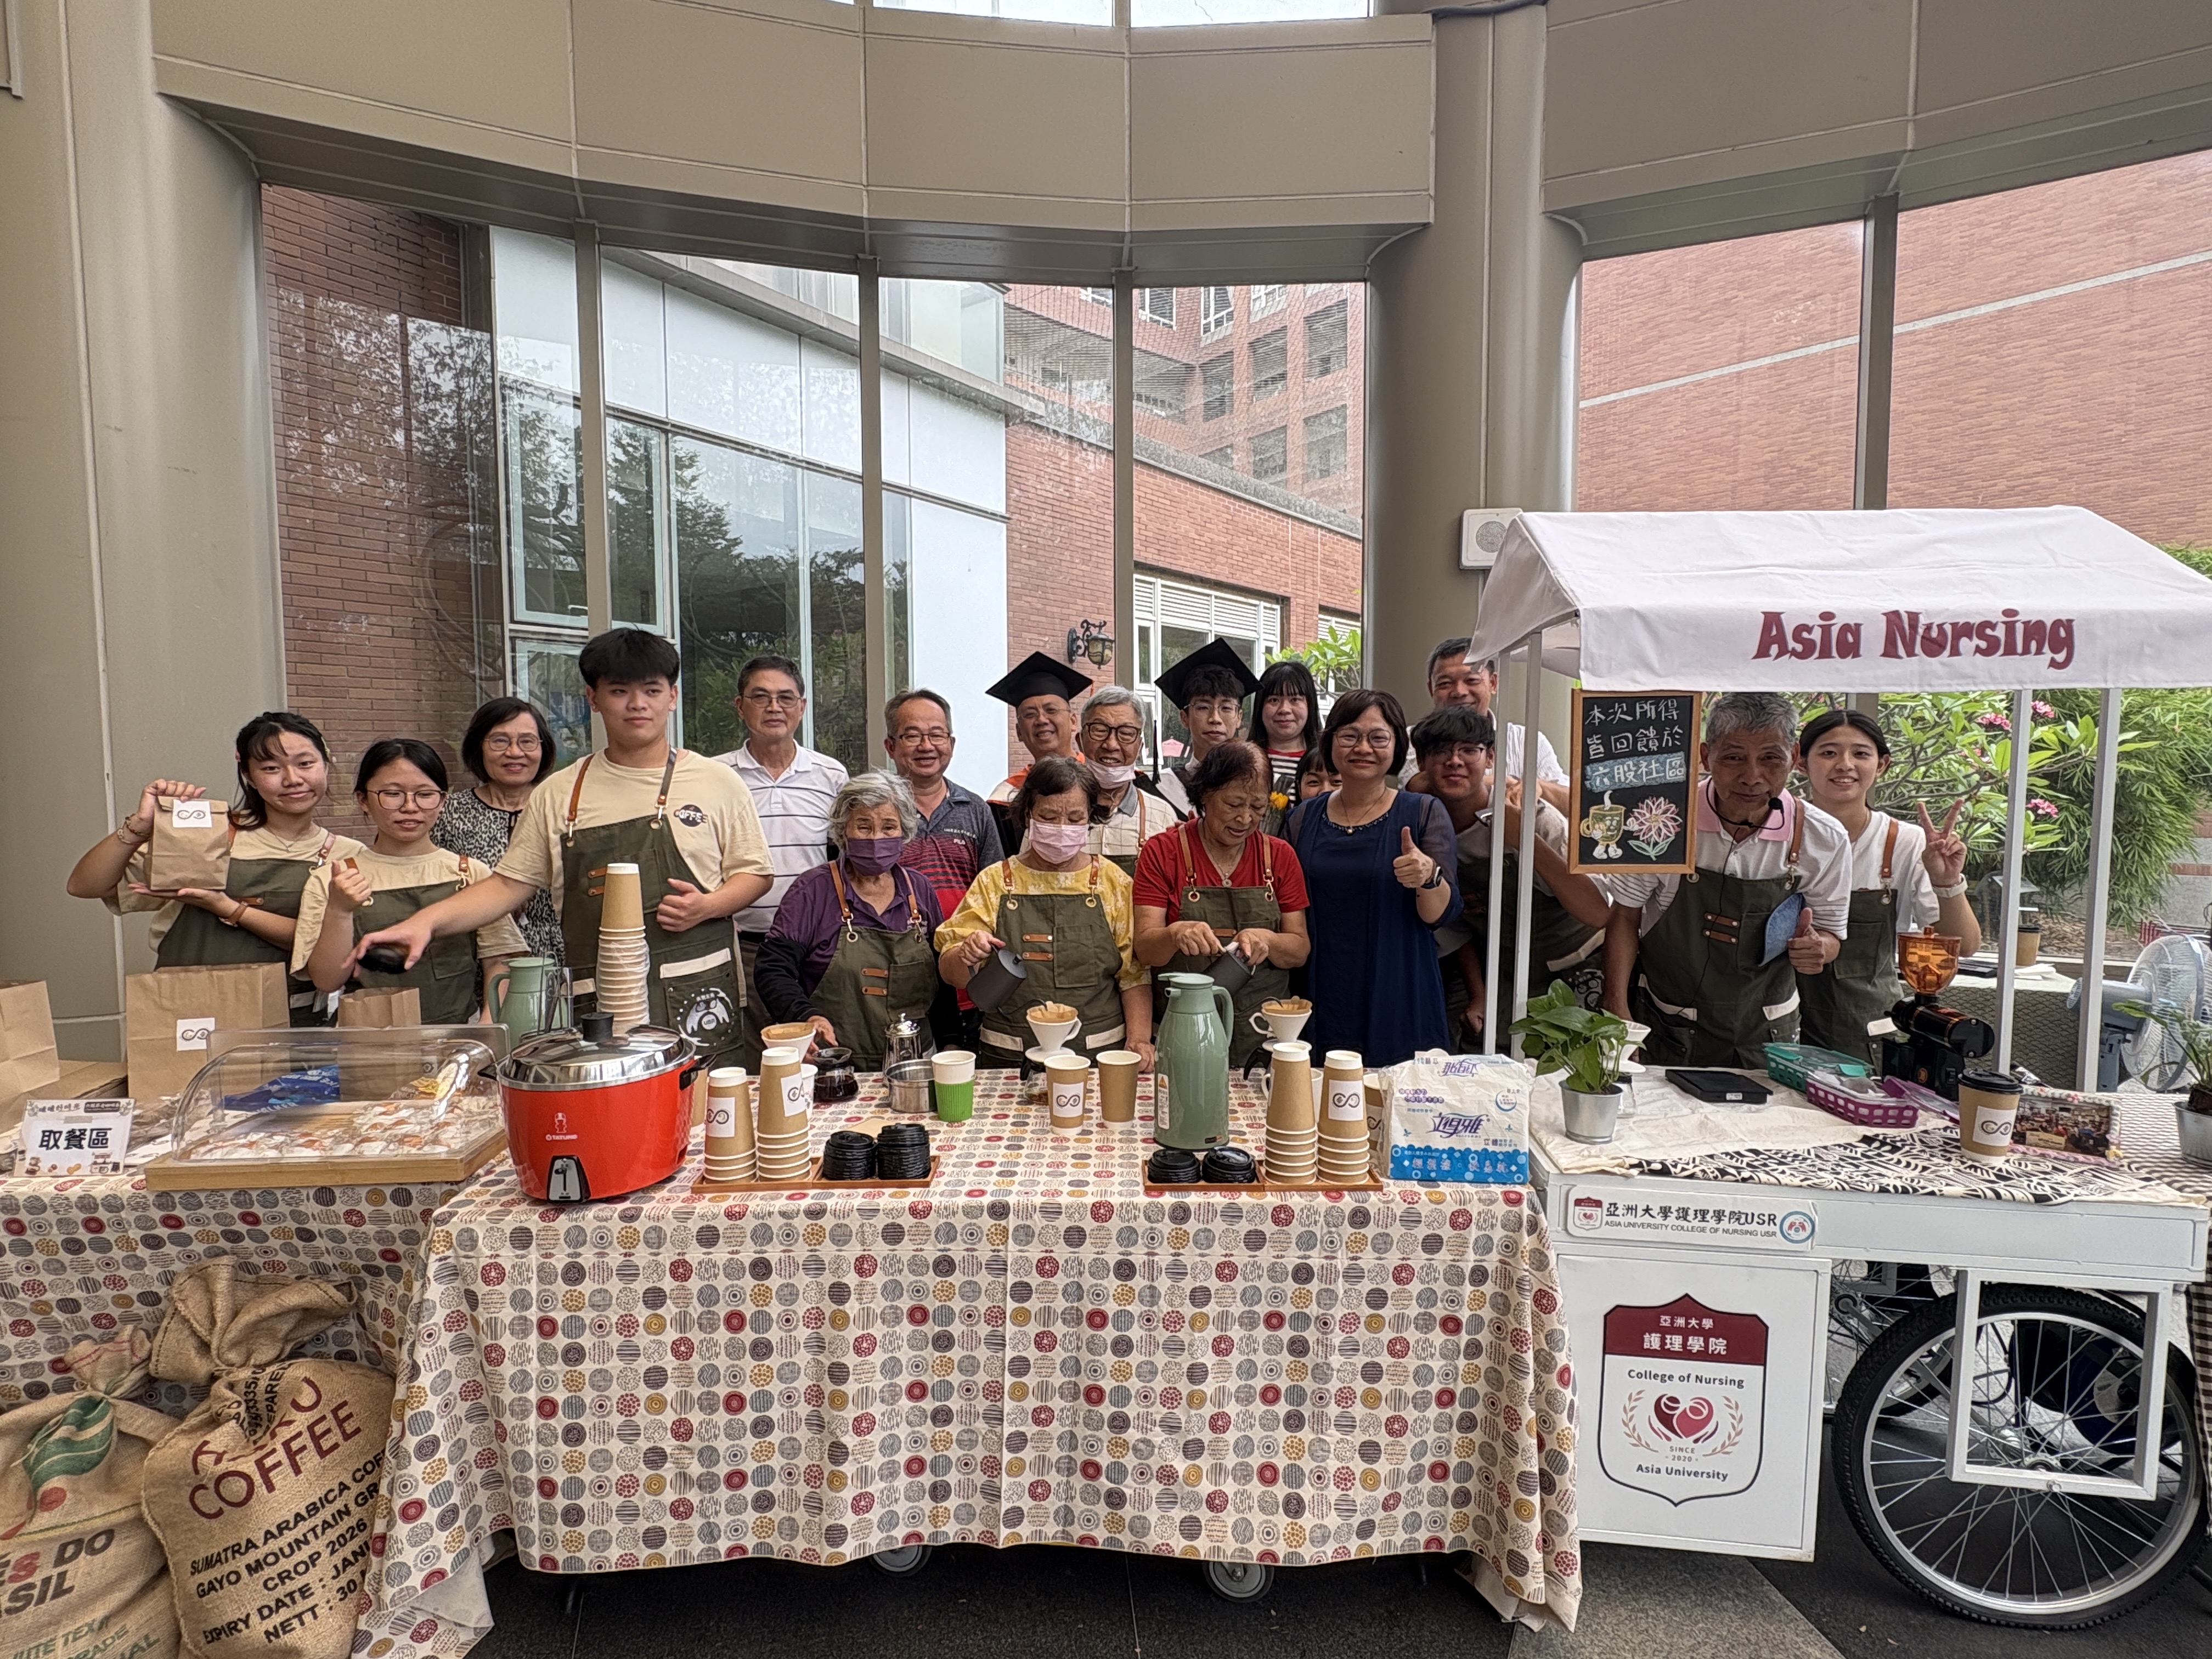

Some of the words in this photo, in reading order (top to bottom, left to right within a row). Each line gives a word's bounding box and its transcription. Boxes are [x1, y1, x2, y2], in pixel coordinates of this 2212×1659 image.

[1751, 611, 1864, 661] Asia
[1878, 608, 2076, 670] Nursing
[1584, 698, 1680, 727] 本次所得
[1586, 725, 1684, 760] 皆回饋於
[1592, 756, 1685, 787] 六股社區
[38, 1127, 113, 1151] 取餐區
[1604, 1220, 1623, 1228] ASIA
[1623, 1221, 1670, 1231] UNIVERSITY
[1671, 1224, 1707, 1234] COLLEGE
[1722, 1228, 1759, 1237] NURSING
[1605, 1201, 1778, 1227] 亞洲大學護理學院USR
[1659, 1315, 1714, 1330] 亞洲大學
[1643, 1332, 1728, 1356] 護理學院
[1627, 1369, 1674, 1384] College
[1678, 1373, 1692, 1383] of
[1695, 1374, 1745, 1390] Nursing
[189, 1400, 362, 1520] COFFEE
[1669, 1446, 1696, 1454] SINCE
[1671, 1454, 1692, 1463] 2020
[1635, 1464, 1662, 1475] Asia
[1665, 1466, 1729, 1482] University
[190, 1537, 260, 1576] SUMATRA
[262, 1481, 352, 1546] ARABICA
[53, 1528, 115, 1569] DO
[196, 1570, 241, 1599] GAYO
[245, 1503, 352, 1578] MOUNTAIN
[262, 1550, 323, 1592] CROP
[325, 1517, 368, 1557] 2026
[0, 1570, 75, 1618] SIL
[257, 1582, 315, 1622] DATE
[263, 1602, 319, 1644] NETT
[336, 1578, 358, 1602] 30
